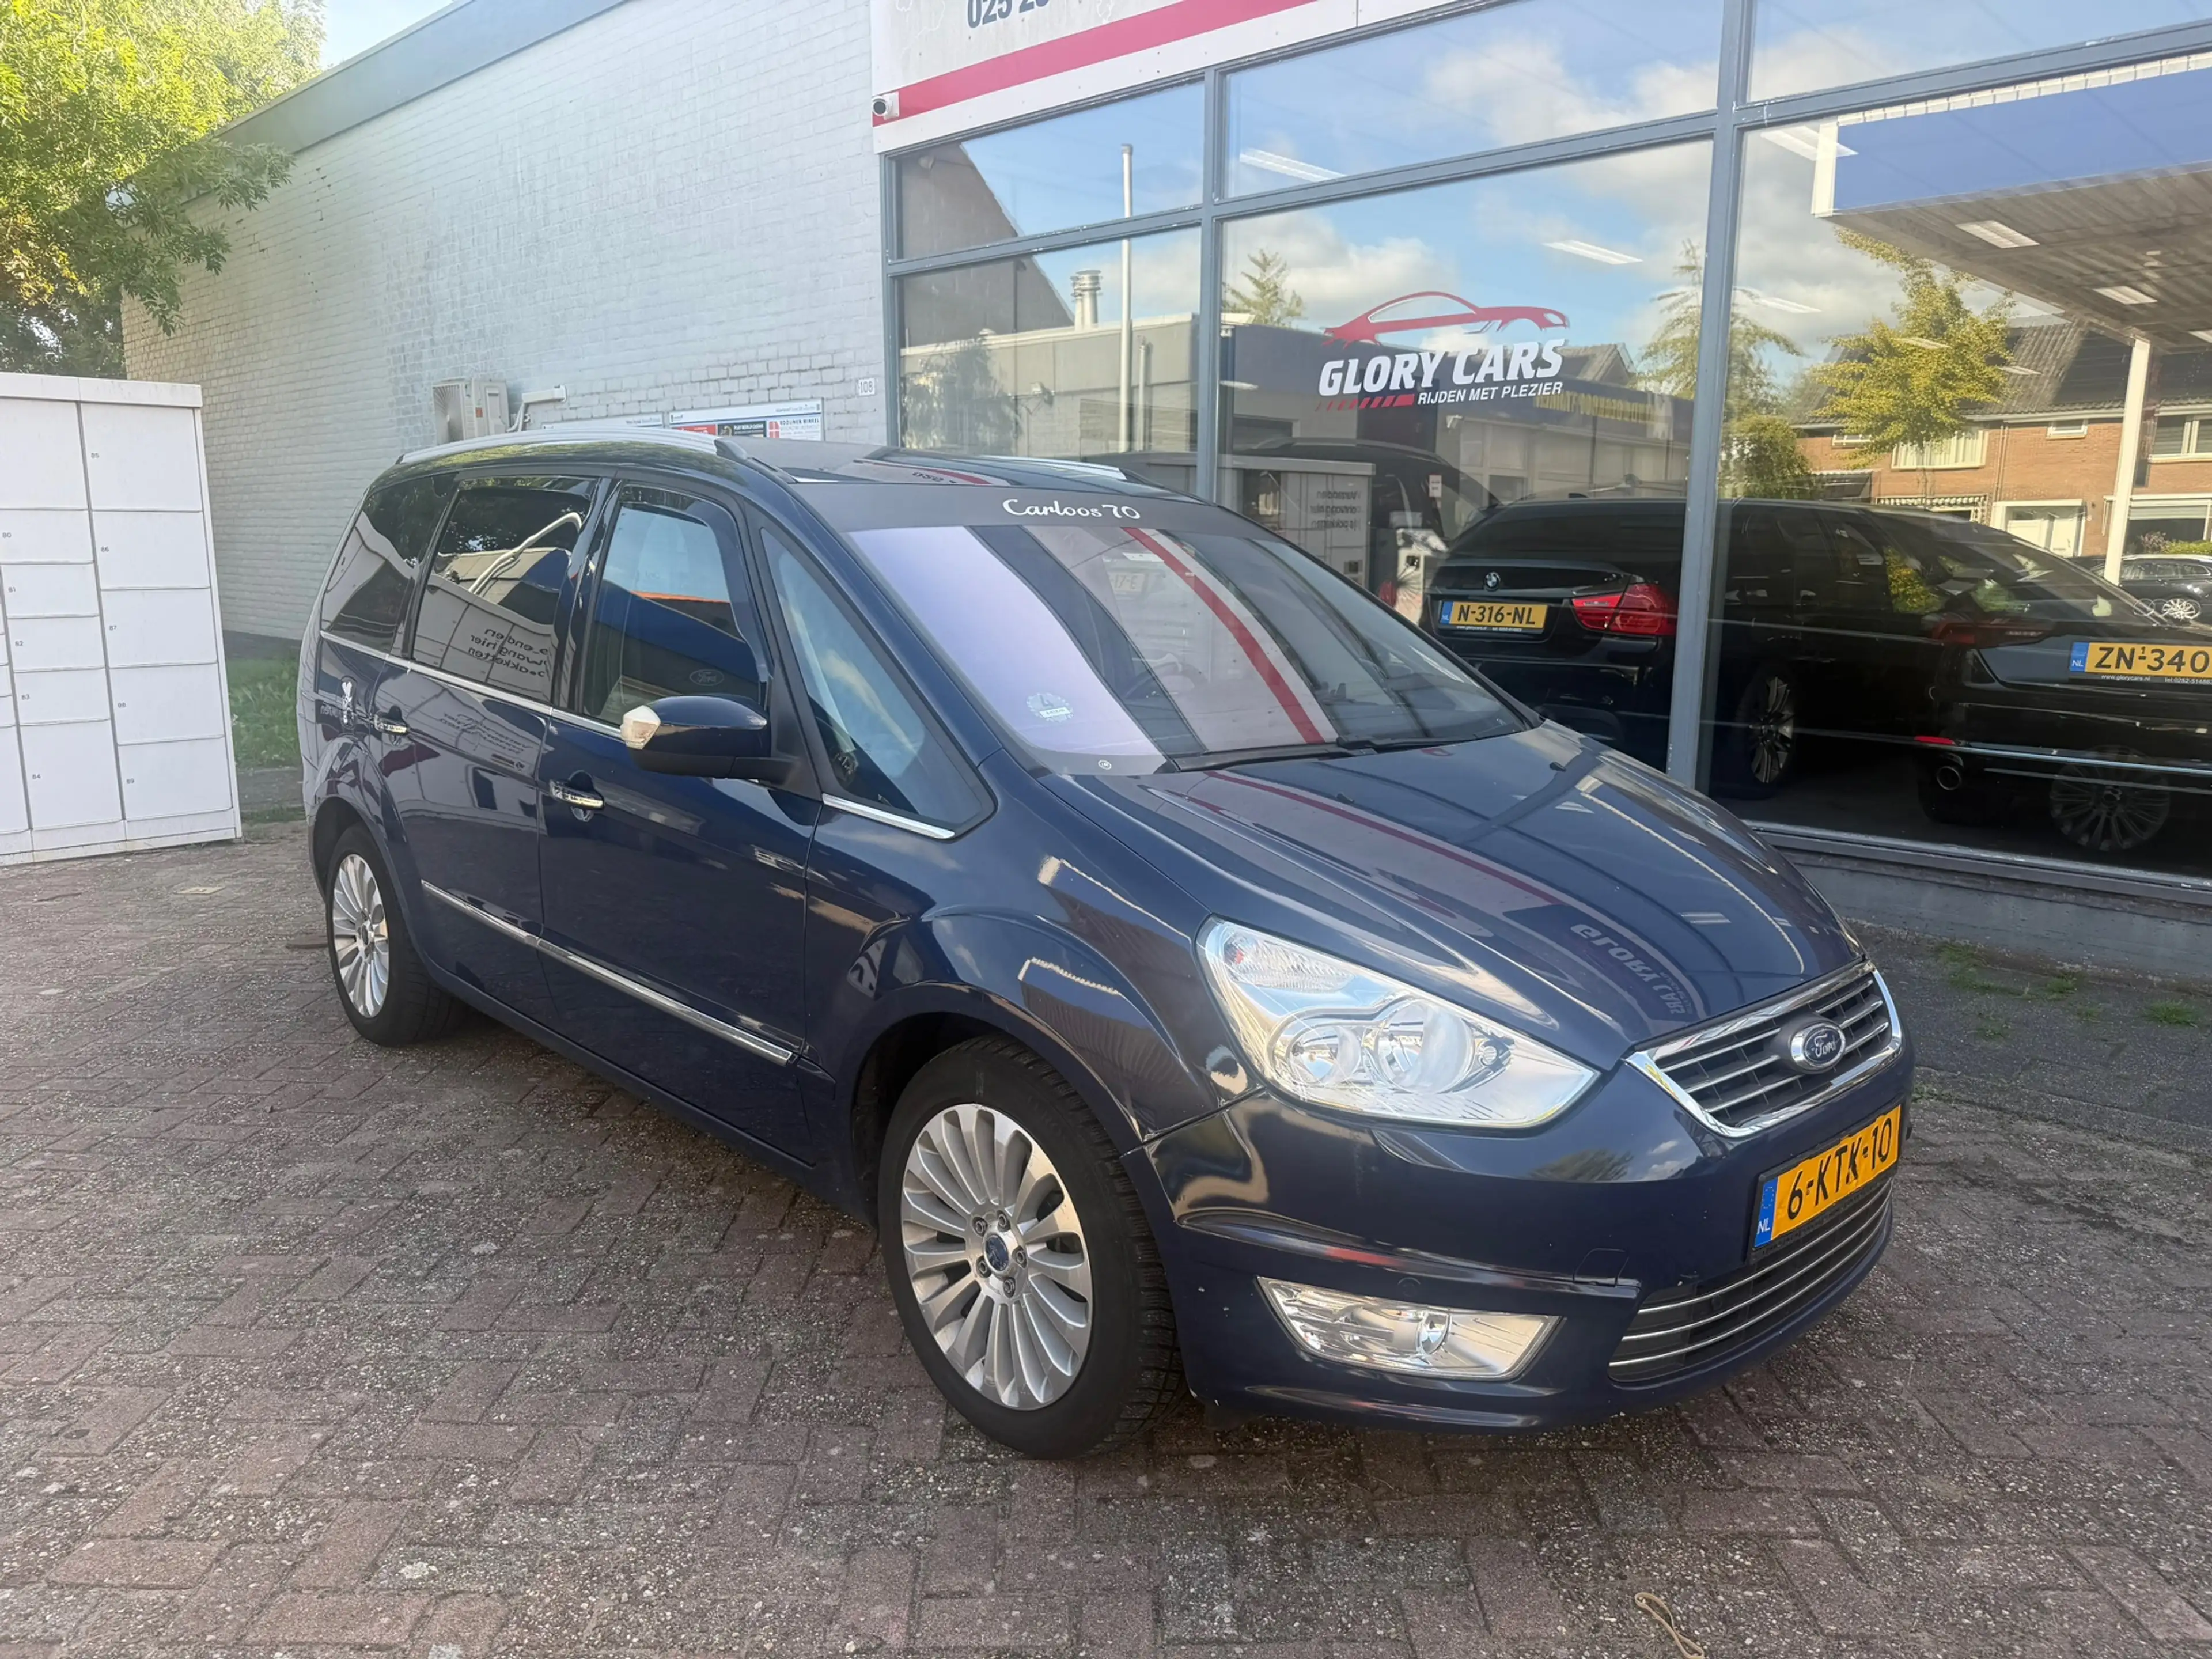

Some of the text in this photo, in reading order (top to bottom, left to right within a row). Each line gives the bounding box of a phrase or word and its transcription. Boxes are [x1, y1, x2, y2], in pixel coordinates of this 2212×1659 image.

[1319, 338, 1565, 396] GLORY CARS
[861, 381, 873, 393] 108
[1418, 382, 1563, 405] RIJDEN MET PLEZIER
[1457, 604, 1536, 625] N-316-NL
[2094, 647, 2210, 673] ZN-340
[1811, 1033, 1840, 1058] Ford
[1787, 1116, 1892, 1221] 6-KTK-10
[1757, 1217, 1771, 1235] NL
